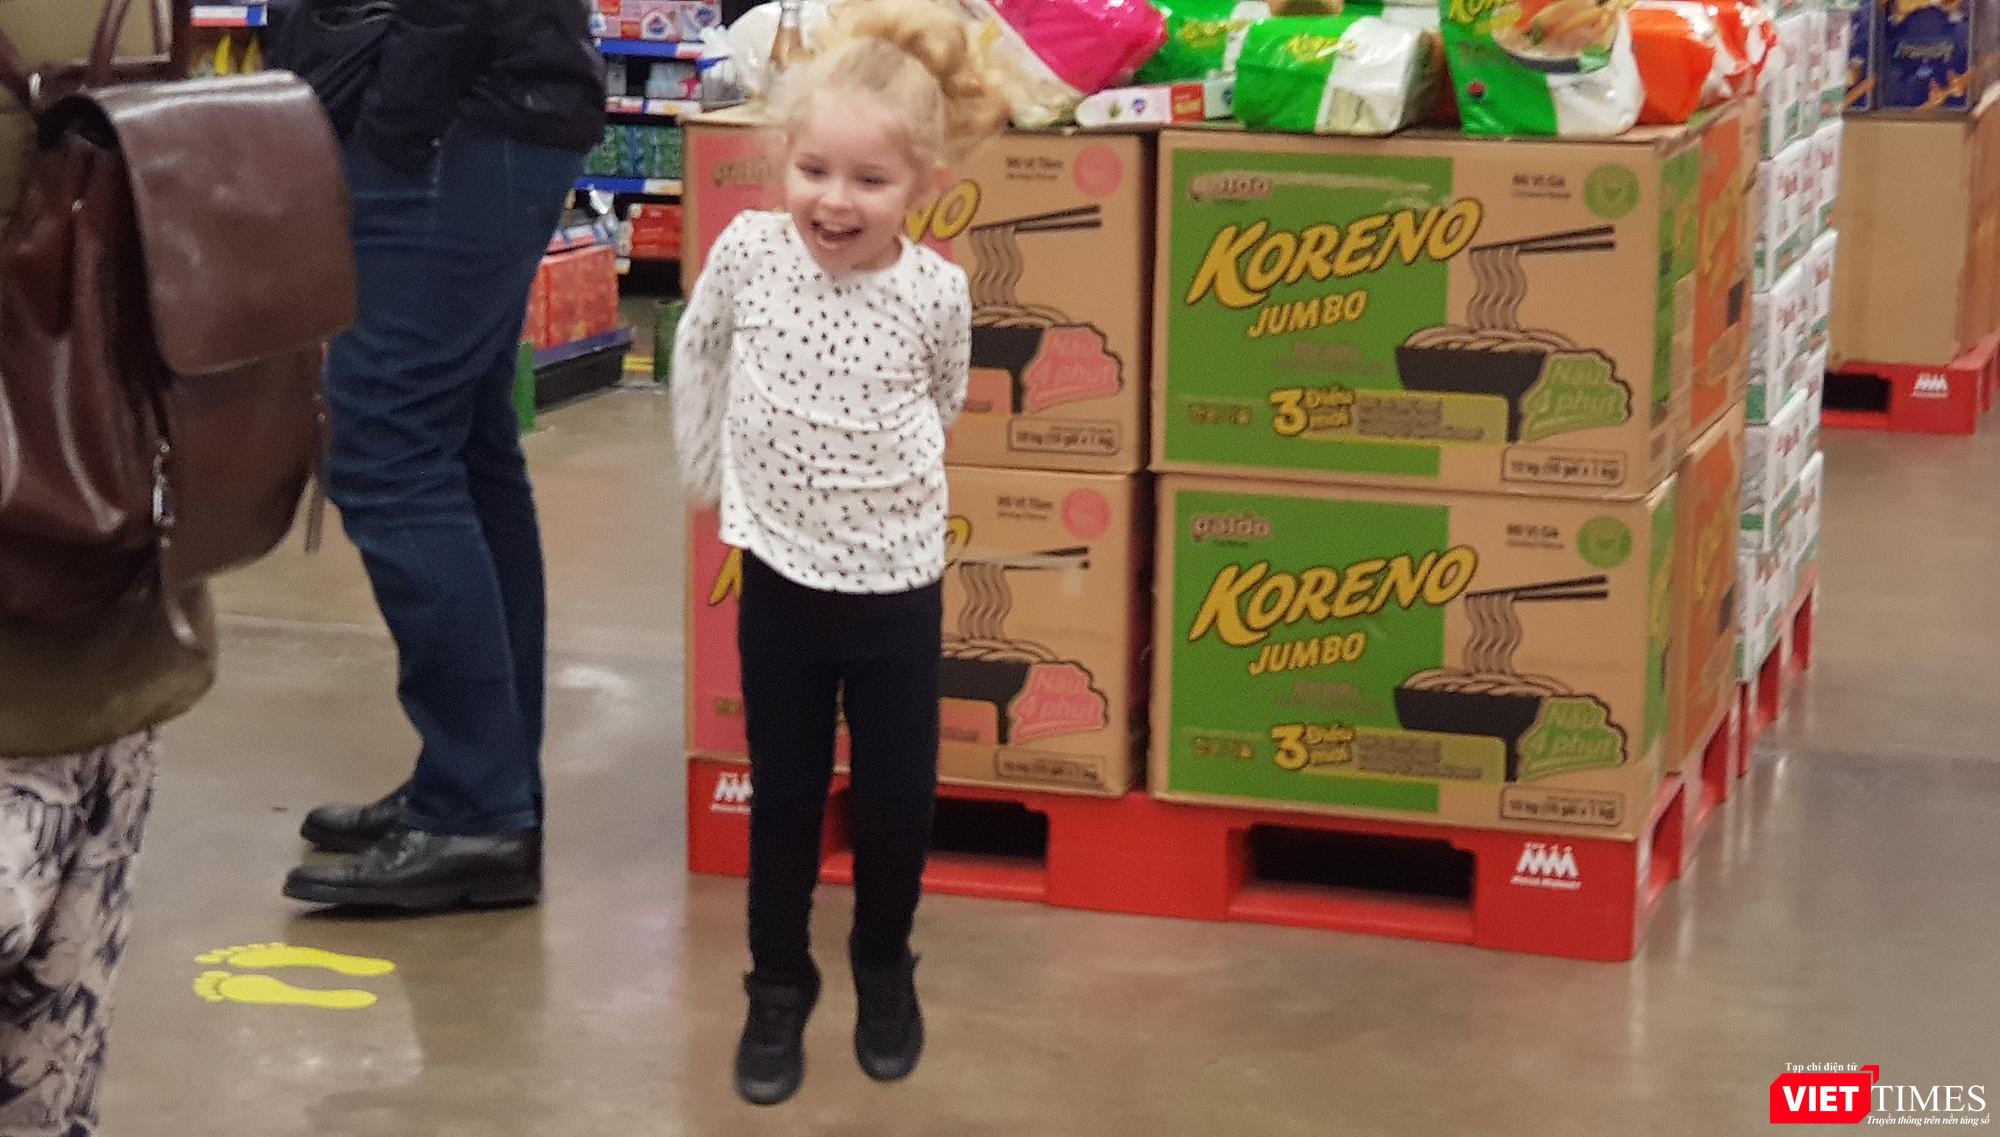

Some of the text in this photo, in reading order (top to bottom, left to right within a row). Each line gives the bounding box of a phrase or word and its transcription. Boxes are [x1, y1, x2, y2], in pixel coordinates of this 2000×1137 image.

[1186, 197, 1484, 309] KORENO
[1247, 289, 1368, 338] JUMBO
[1269, 387, 1309, 436] 3
[1188, 544, 1480, 647] KORENO
[1248, 632, 1368, 676] JUMBO
[1270, 723, 1310, 772] 3
